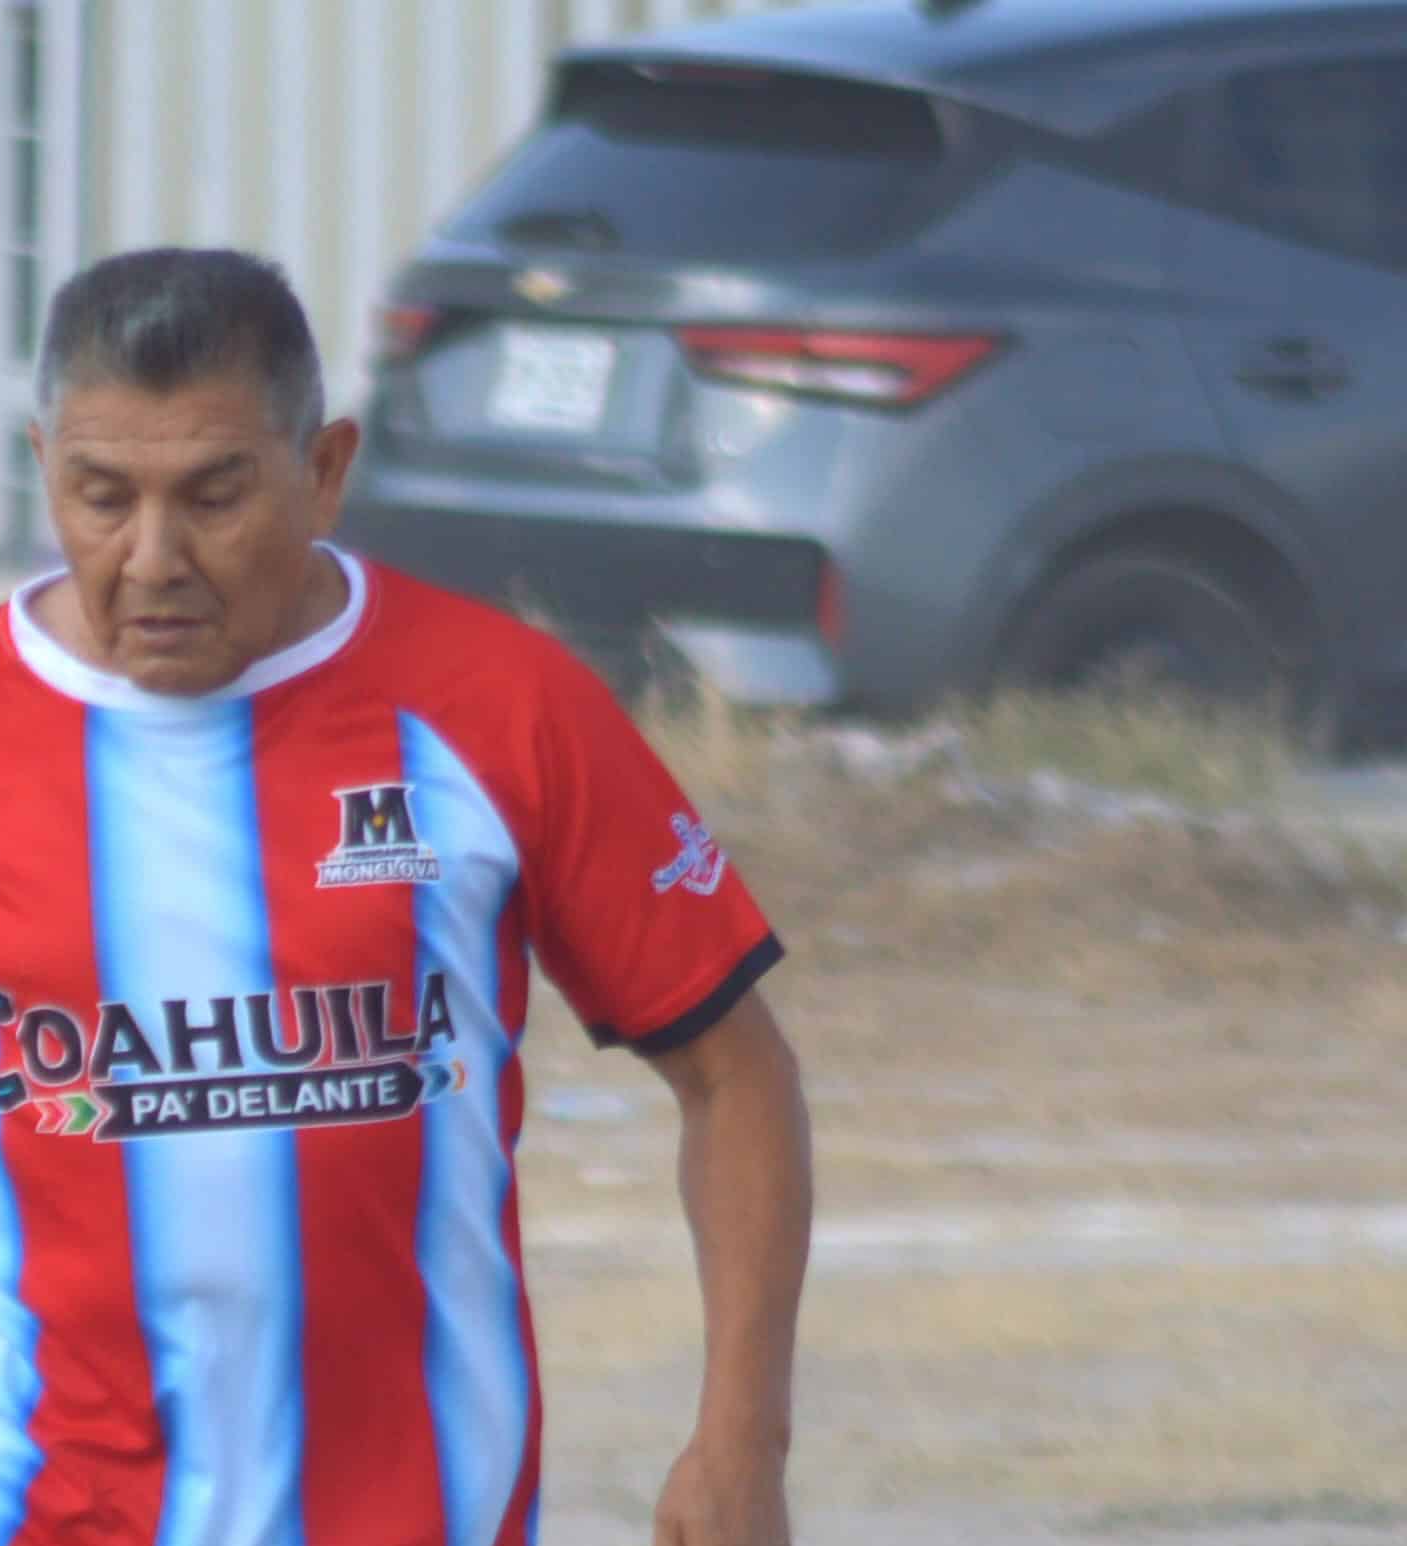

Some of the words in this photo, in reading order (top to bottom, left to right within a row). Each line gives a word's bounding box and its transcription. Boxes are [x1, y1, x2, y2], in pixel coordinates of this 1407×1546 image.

[340, 785, 417, 847] M
[323, 860, 439, 883] MONCLOVA
[130, 1092, 195, 1126] PA'
[210, 1072, 401, 1122] DELANTE
